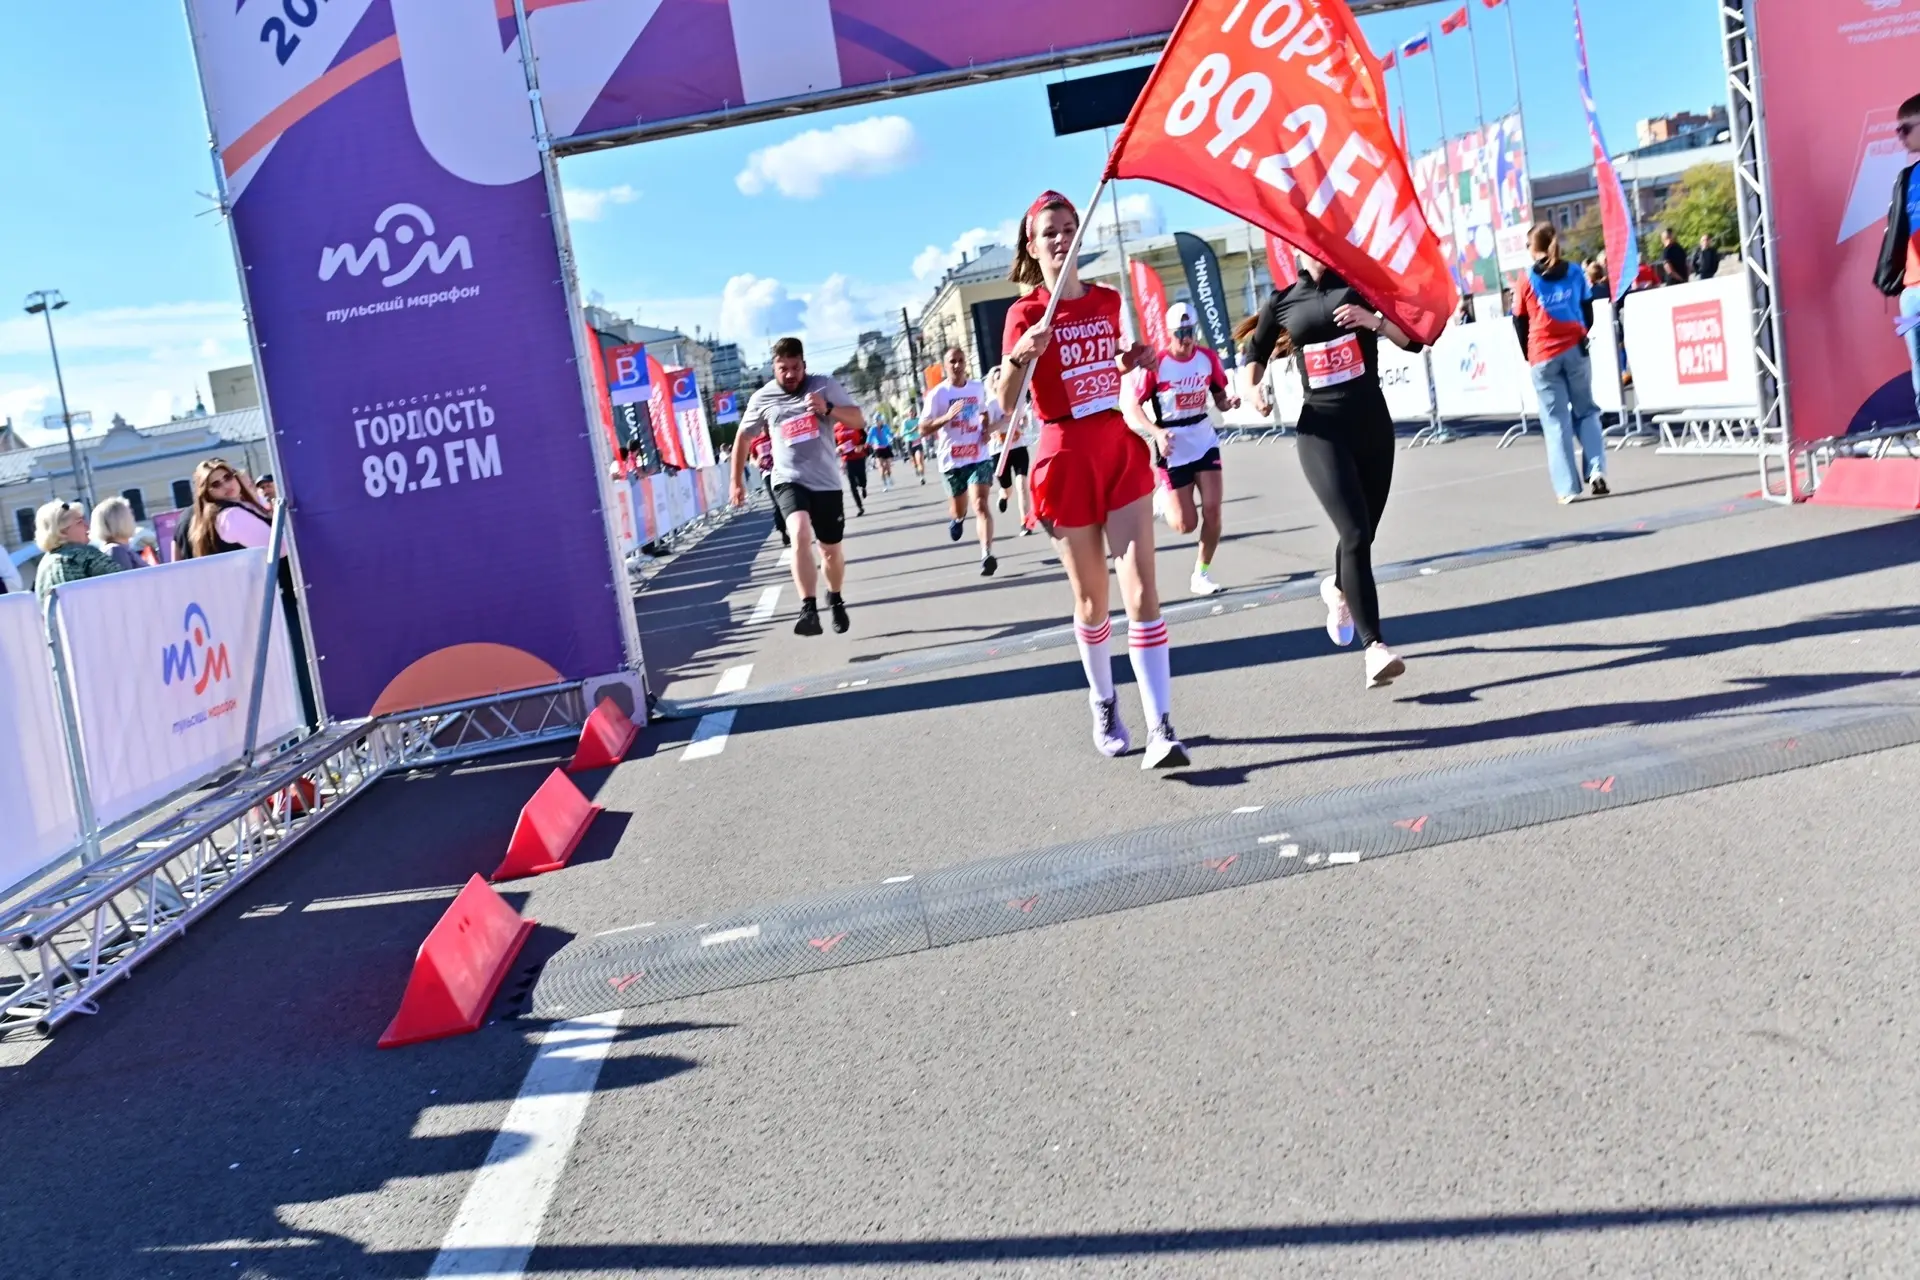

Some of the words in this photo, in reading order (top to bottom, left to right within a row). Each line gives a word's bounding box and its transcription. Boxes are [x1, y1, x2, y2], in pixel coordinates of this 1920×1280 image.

[1164, 52, 1328, 193] 89.2
[1305, 130, 1428, 276] FM
[326, 296, 404, 323] тульский
[406, 285, 480, 308] марафон
[1055, 320, 1114, 343] ГОРДОСТЬ
[1060, 340, 1096, 367] 89.2
[1312, 346, 1354, 370] 2159
[616, 356, 640, 386] B
[1074, 371, 1119, 397] 2392
[352, 384, 487, 415] РАДИОСТАНЦИЯ
[673, 377, 692, 398] C
[718, 398, 732, 415] D
[355, 398, 495, 448] ГОРДОСТЬ
[362, 445, 442, 498] 89.2
[443, 434, 503, 484] FM
